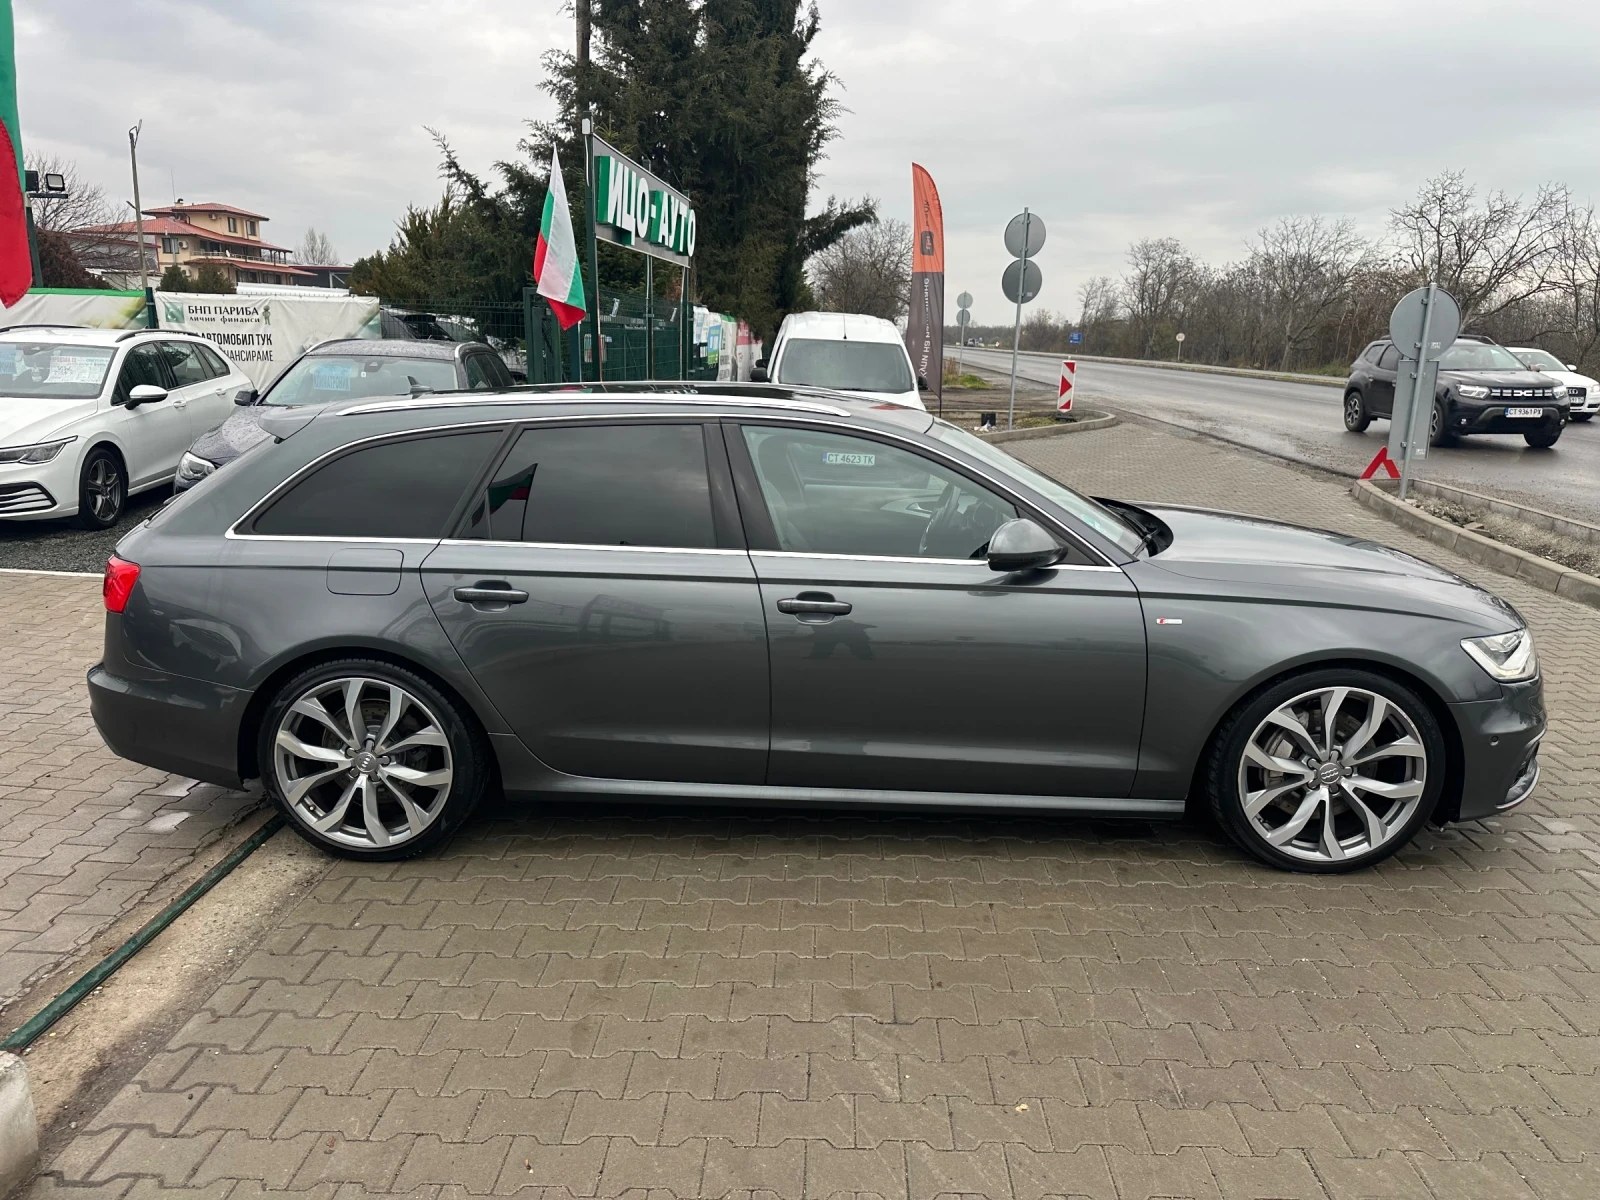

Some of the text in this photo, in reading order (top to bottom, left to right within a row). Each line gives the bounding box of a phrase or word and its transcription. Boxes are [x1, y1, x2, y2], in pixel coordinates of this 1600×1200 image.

[607, 156, 696, 257] ИЦО-АУТО
[188, 305, 259, 316] БНП ПАРИБА
[220, 316, 260, 324] финанси
[256, 334, 273, 346] ТУК
[224, 350, 274, 362] НАНСИРАМЕ
[828, 454, 874, 465] CT 4623 TK
